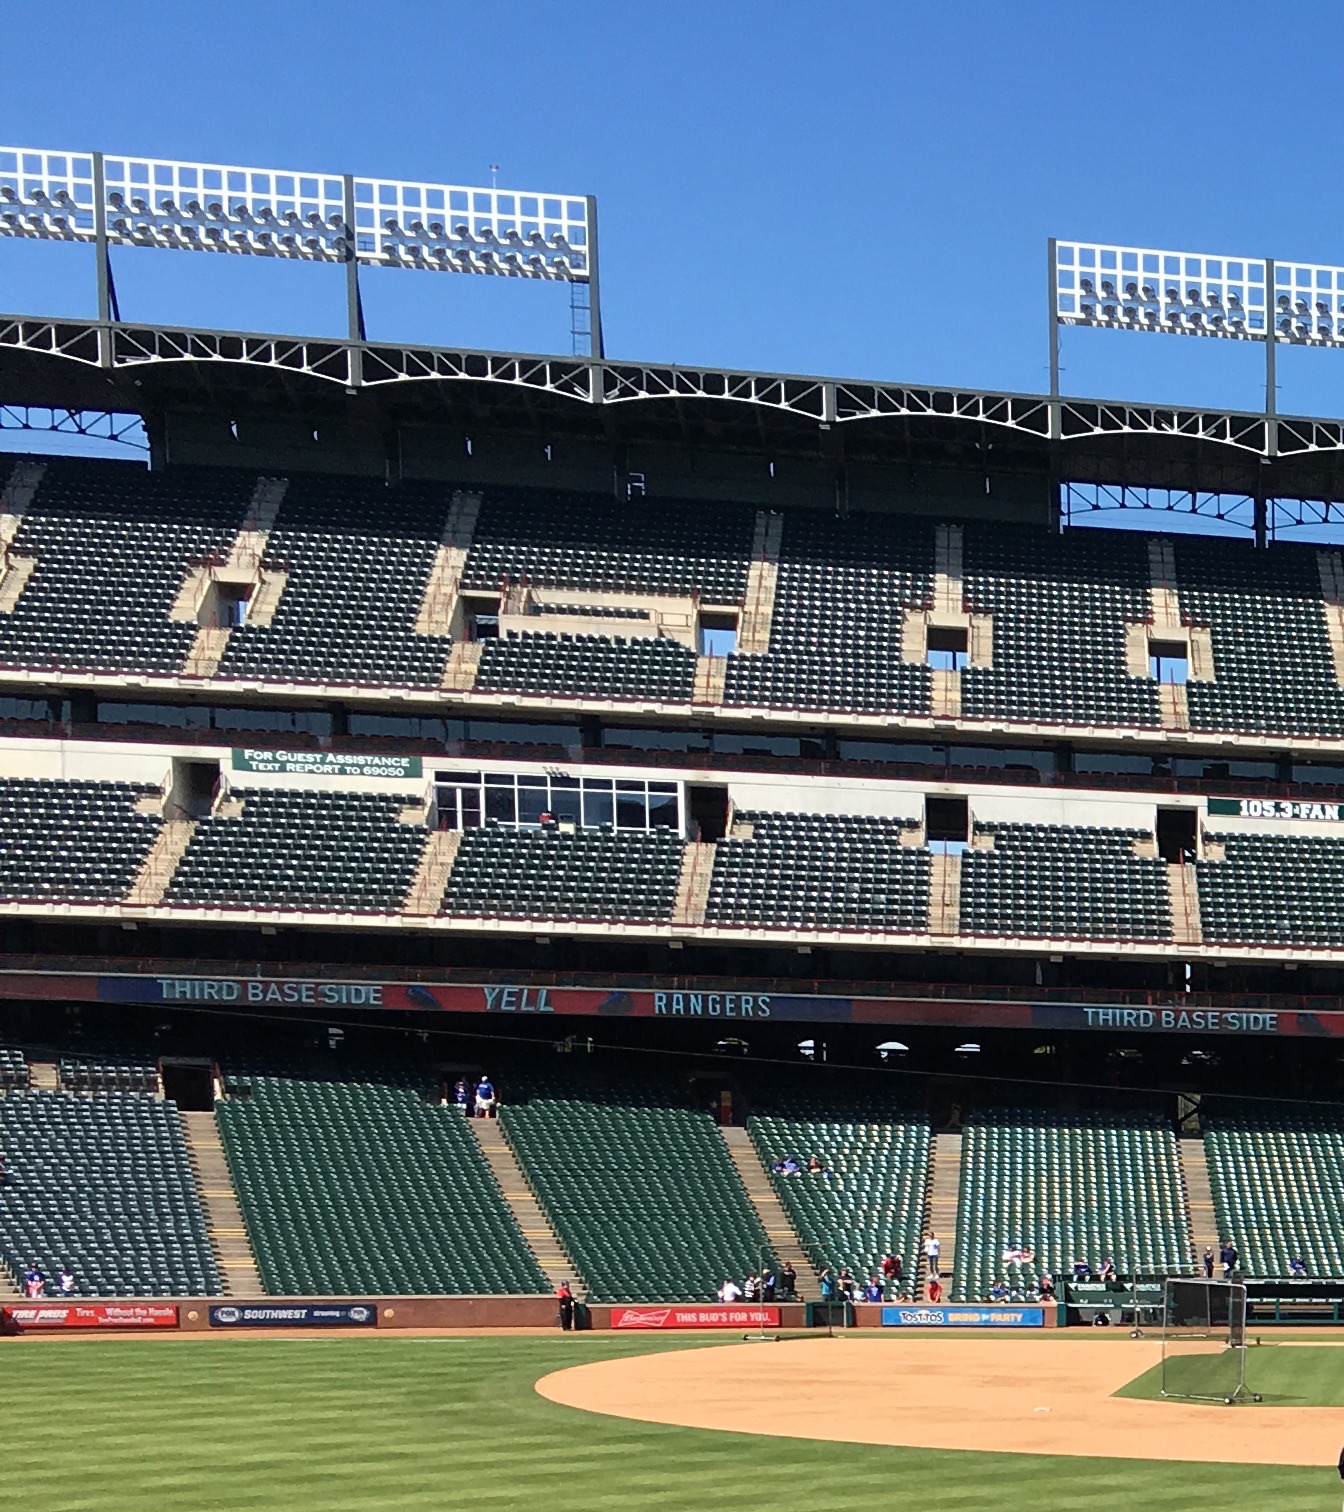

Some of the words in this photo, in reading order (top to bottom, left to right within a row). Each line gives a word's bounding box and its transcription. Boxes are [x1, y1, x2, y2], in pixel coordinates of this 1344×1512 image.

[244, 749, 273, 760] FOR
[276, 751, 322, 763] GUEST
[325, 753, 410, 767] ASSISTANCE
[249, 761, 281, 772] TEXT
[286, 763, 340, 774] REPORT
[345, 766, 361, 775] TO
[363, 766, 405, 777] 69050
[1240, 800, 1294, 818] 105.3
[1299, 803, 1340, 820] FAN
[156, 979, 240, 1001] THIRD
[247, 981, 316, 1003] BASE
[323, 983, 383, 1005] SIDE
[483, 986, 554, 1012] YELL
[653, 992, 771, 1018] RANGERS
[1083, 1007, 1153, 1028] THIRD
[1161, 1010, 1221, 1031] BASE
[1227, 1012, 1278, 1032] SIDE
[243, 1309, 308, 1319] SOUTHWEST
[675, 1312, 697, 1322] THIS
[699, 1312, 727, 1322] BUD'S
[730, 1312, 748, 1322] FOR
[750, 1312, 771, 1322] YOU.
[990, 1312, 1023, 1322] PARTY
